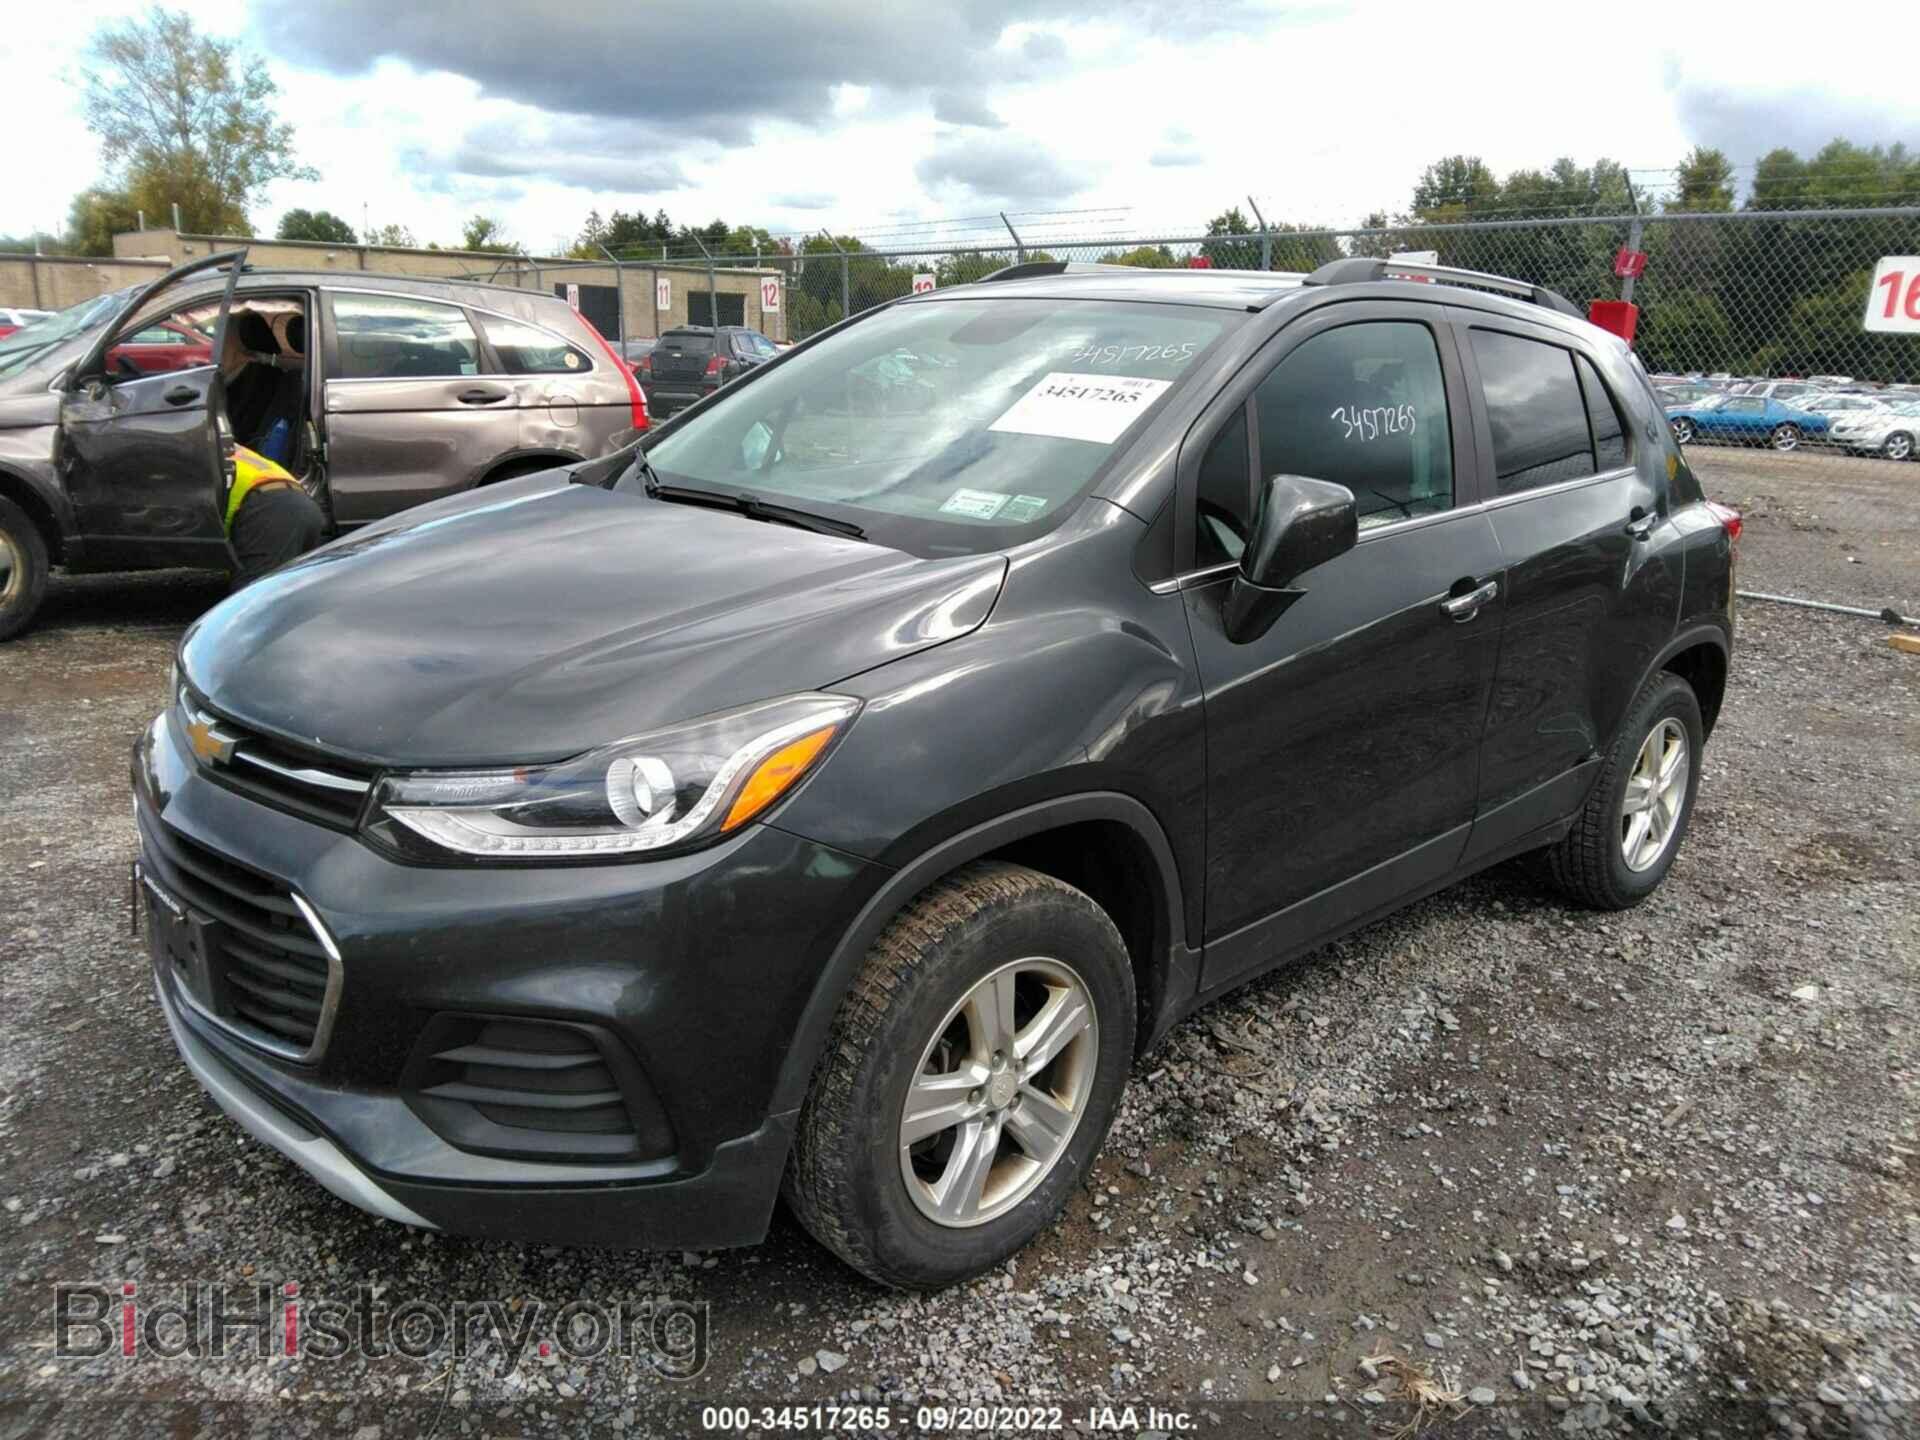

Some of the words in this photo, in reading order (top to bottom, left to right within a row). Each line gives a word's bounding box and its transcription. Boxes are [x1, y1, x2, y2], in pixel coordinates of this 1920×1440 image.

[659, 285, 669, 305] 11
[763, 284, 778, 306] 12
[1071, 343, 1196, 364] 34517265
[1038, 384, 1142, 403] 34517265
[1331, 404, 1416, 441] 34517265
